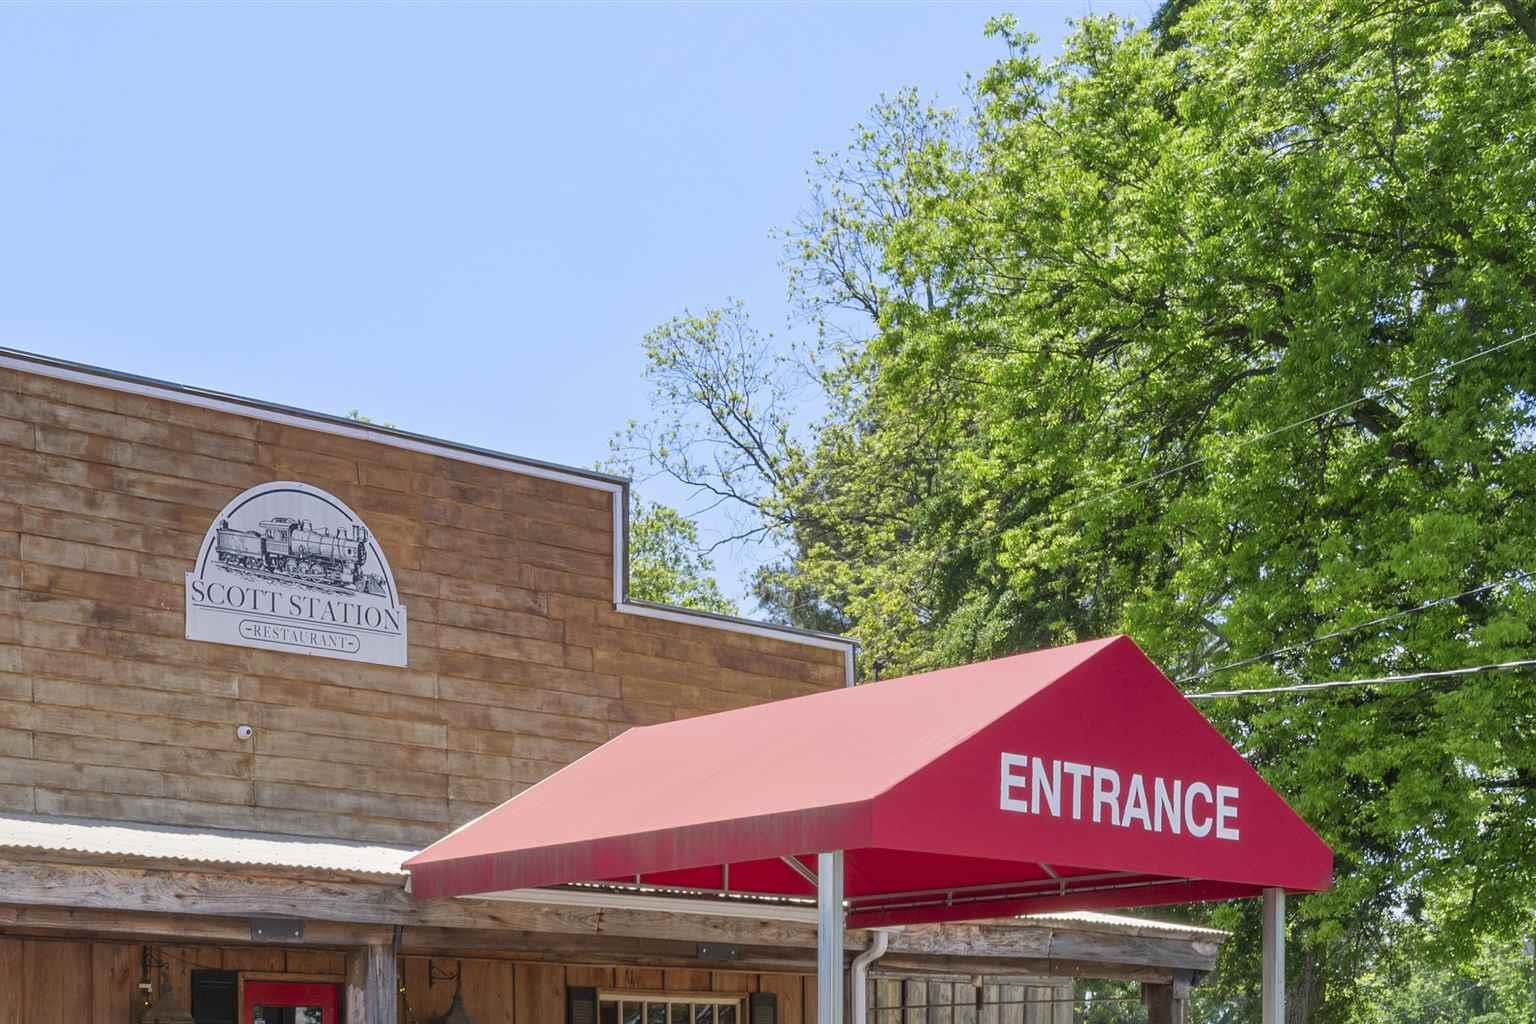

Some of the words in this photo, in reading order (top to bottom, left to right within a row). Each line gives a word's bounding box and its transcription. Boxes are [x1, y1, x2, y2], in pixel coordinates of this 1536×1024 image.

[191, 580, 282, 613] SCOTT
[289, 594, 400, 631] STATION
[253, 624, 349, 649] RESTAURANT
[1000, 751, 1240, 841] ENTRANCE
